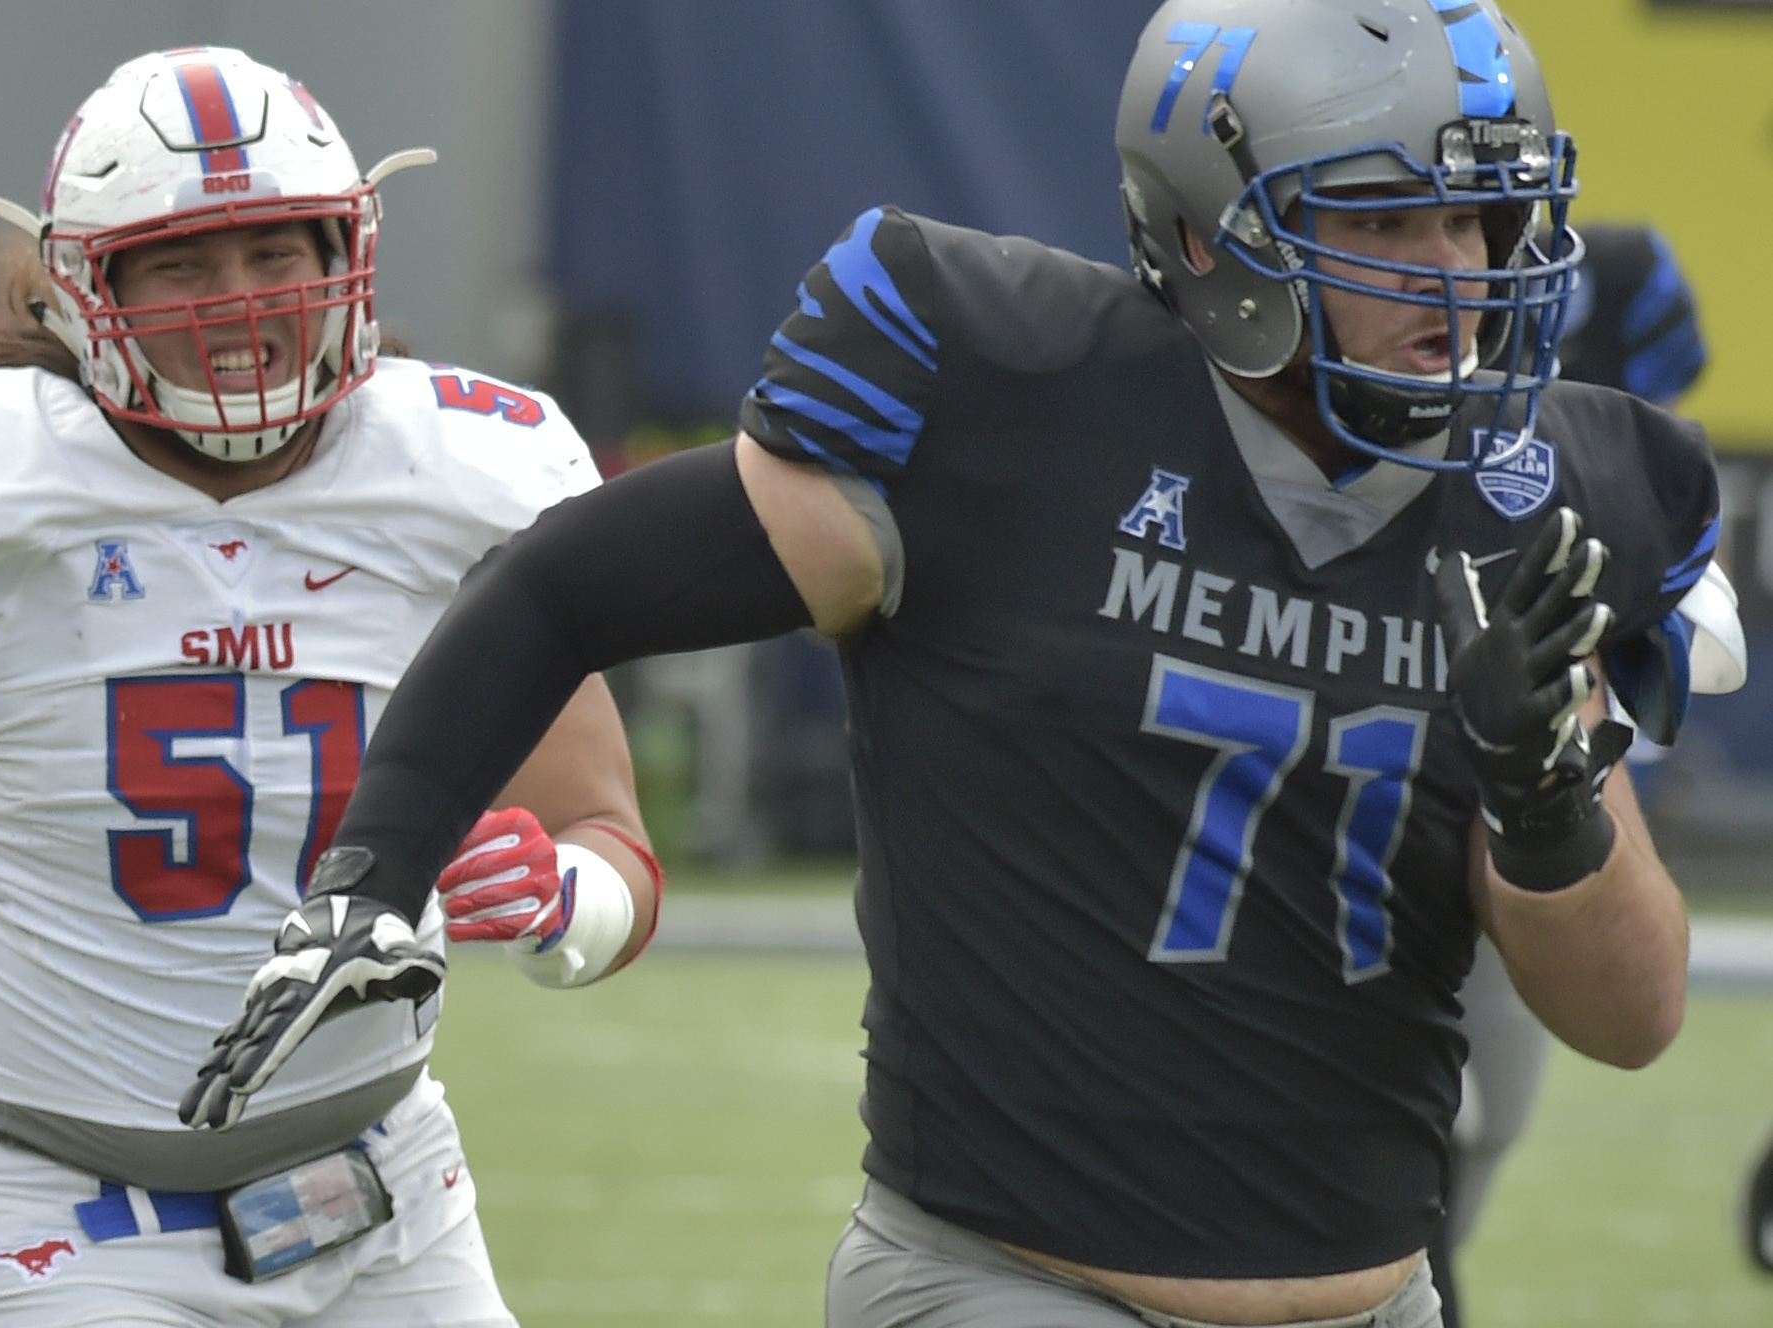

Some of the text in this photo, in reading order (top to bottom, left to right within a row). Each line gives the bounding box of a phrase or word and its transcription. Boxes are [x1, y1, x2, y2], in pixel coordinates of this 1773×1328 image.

[1150, 21, 1257, 135] 71
[180, 621, 295, 673] SMU
[1097, 547, 1450, 693] MEMPHI
[105, 672, 366, 923] 51
[1139, 652, 1430, 986] 71
